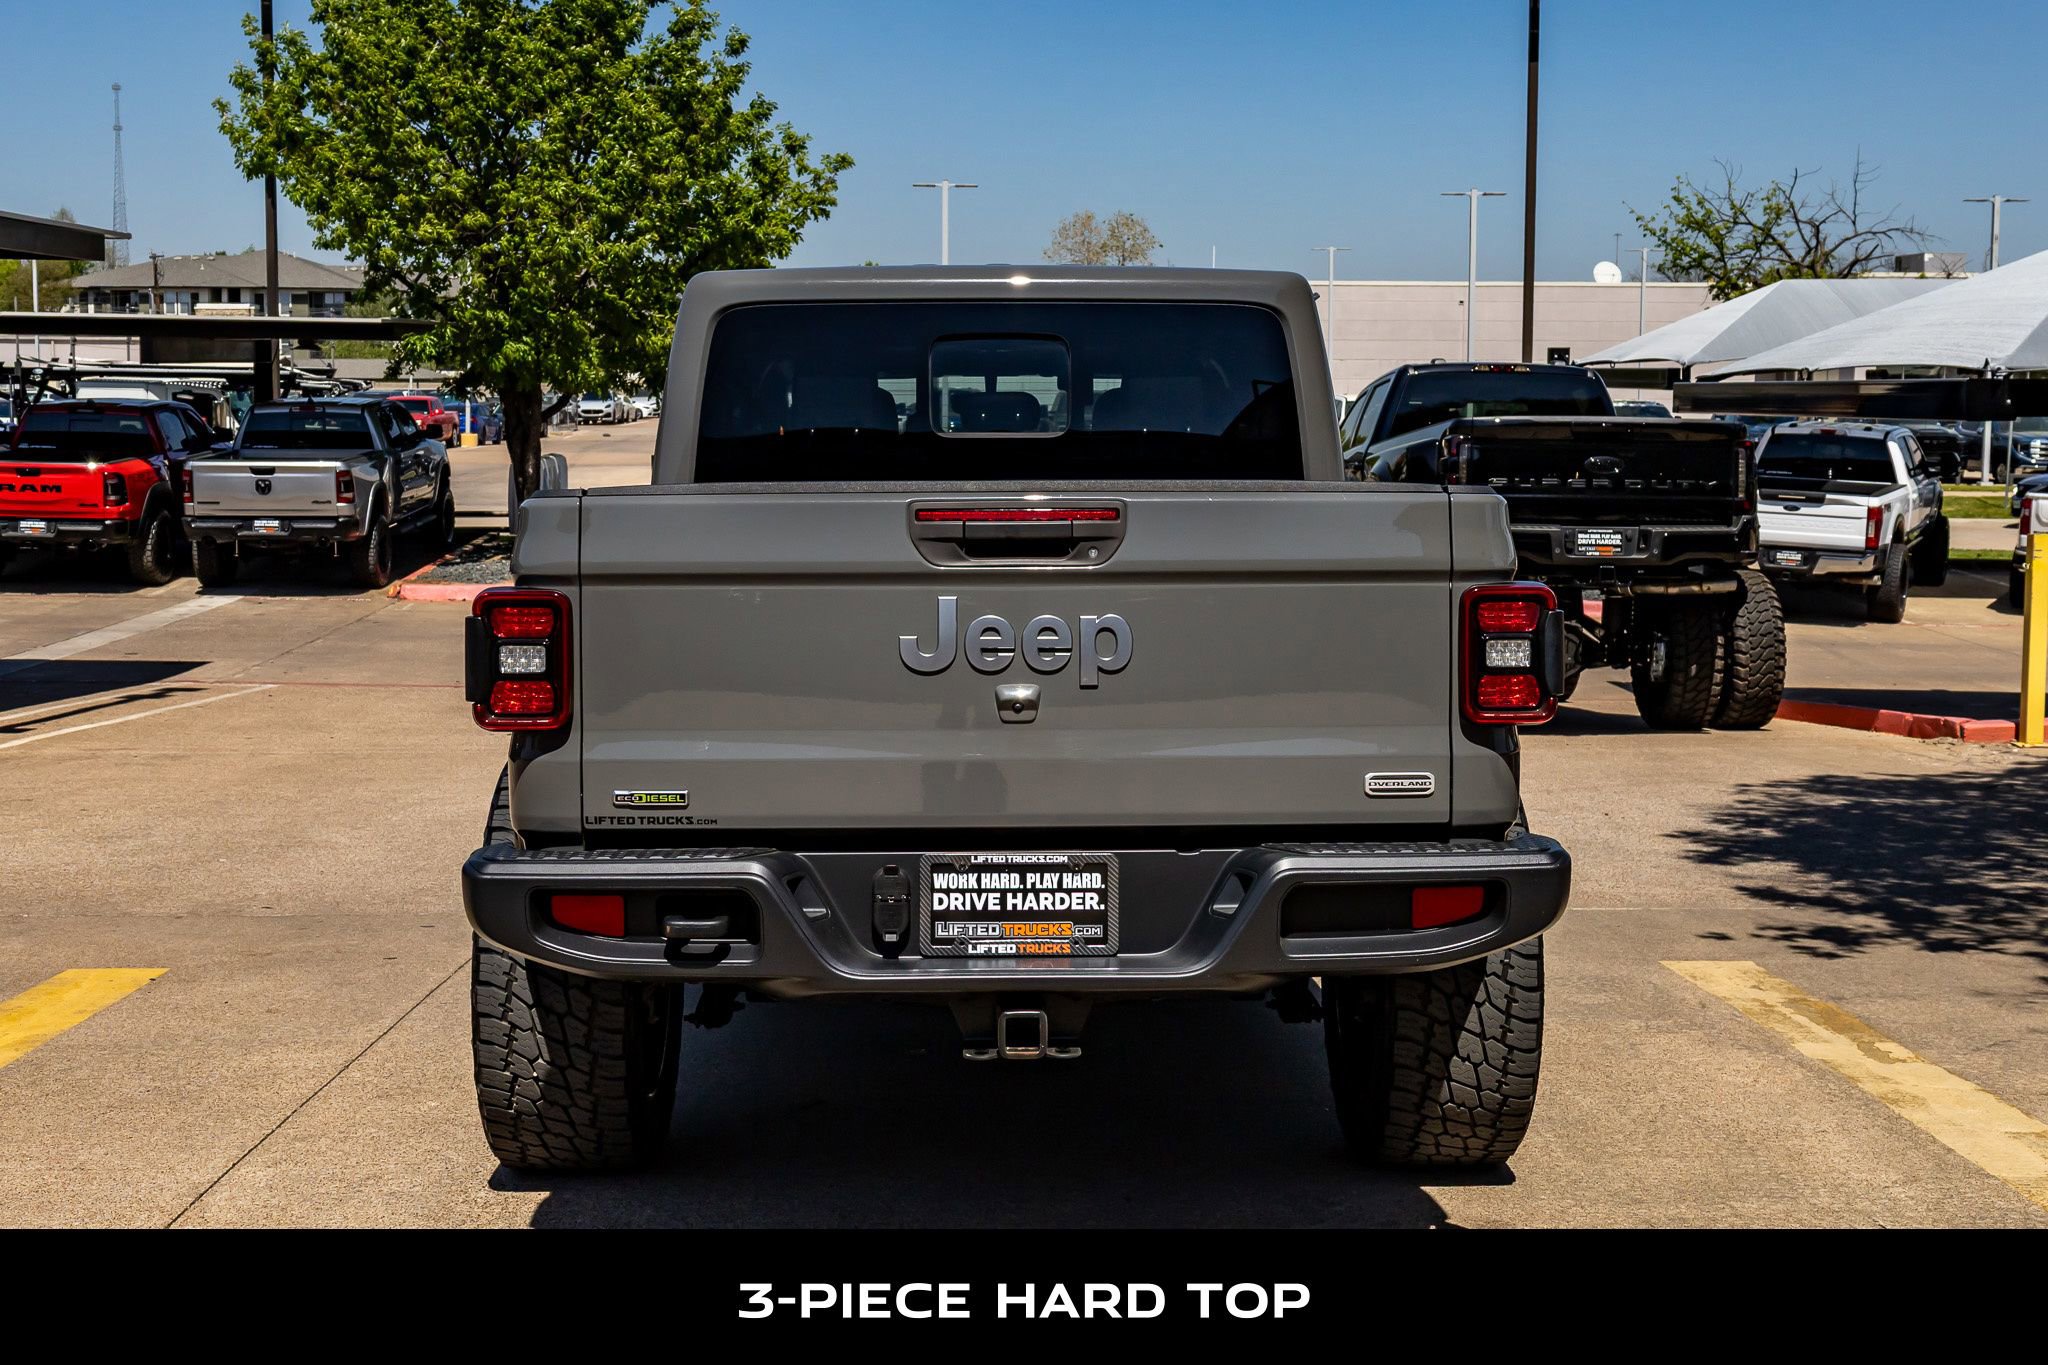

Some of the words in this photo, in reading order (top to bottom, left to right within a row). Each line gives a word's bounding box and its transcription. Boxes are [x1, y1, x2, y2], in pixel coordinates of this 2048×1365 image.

[0, 483, 62, 493] RAM
[898, 595, 1133, 689] Jeep
[932, 873, 978, 889] WORK
[981, 873, 1023, 889] HARD.
[1026, 873, 1060, 889] PLAY
[1062, 873, 1105, 889] HARD.
[933, 892, 1000, 911] DRIVE
[1006, 892, 1105, 910] HARDER.
[968, 944, 1016, 954] LIFTED
[1018, 944, 1071, 954] TRUCKS
